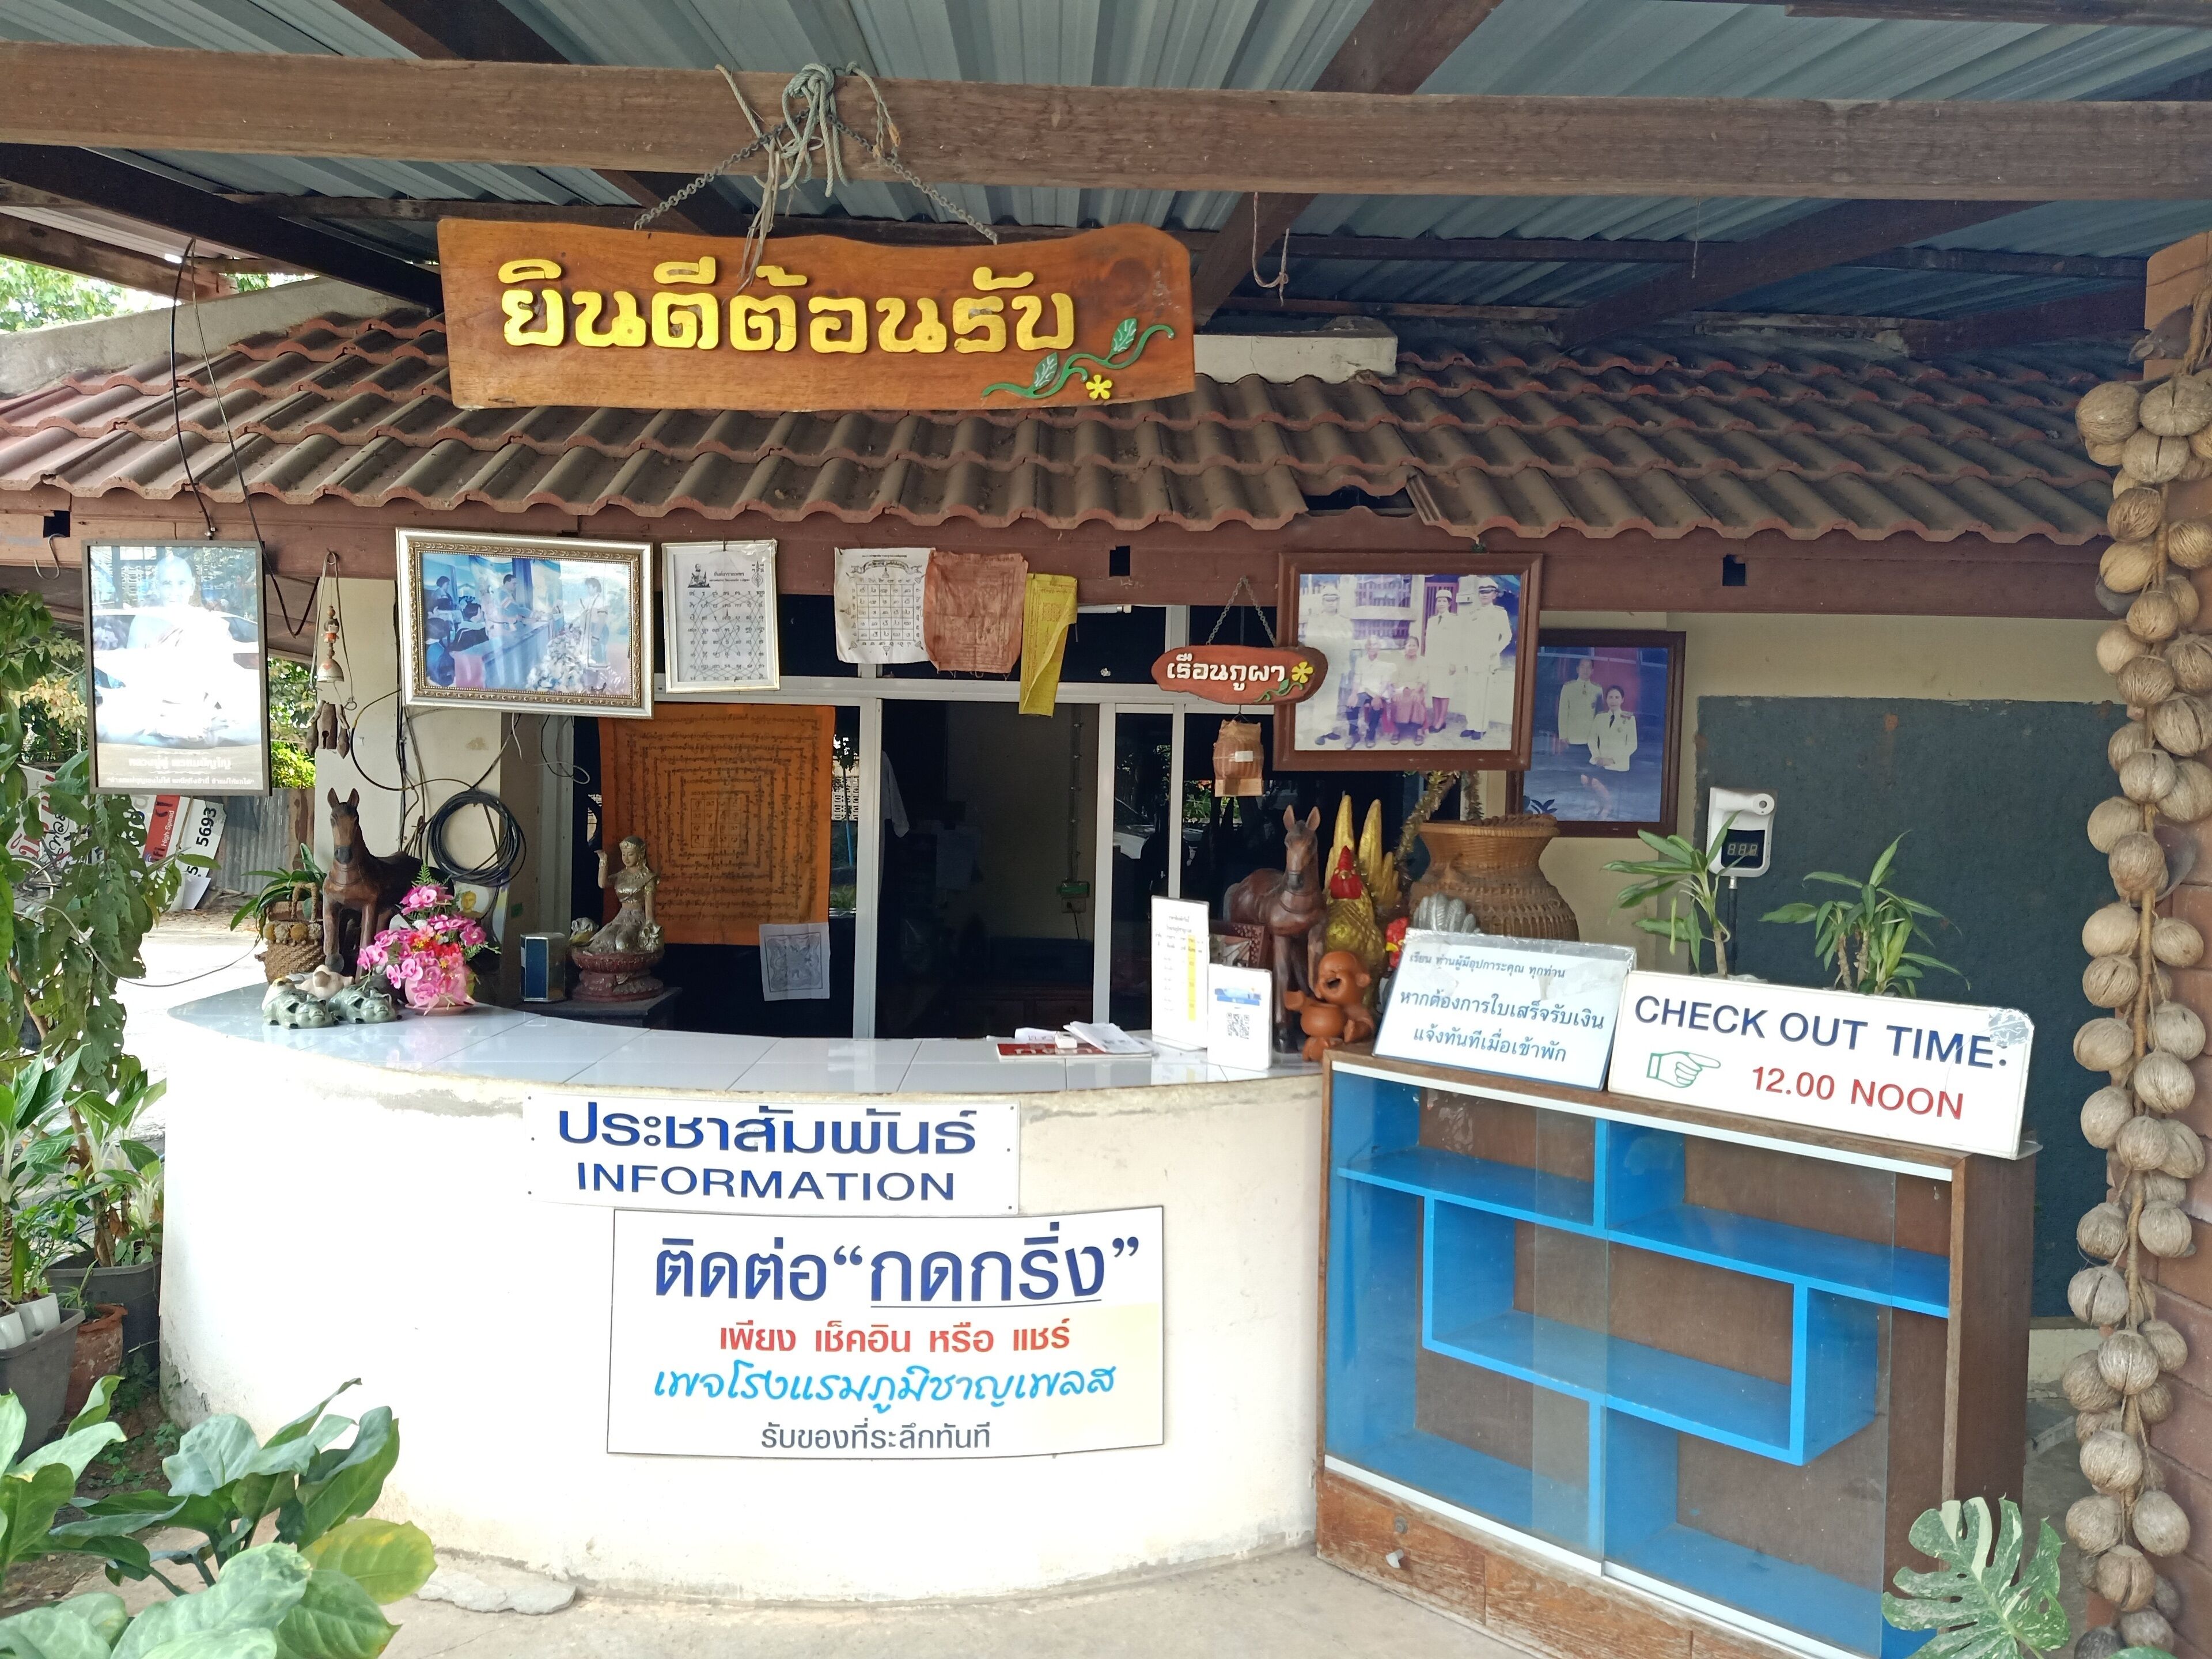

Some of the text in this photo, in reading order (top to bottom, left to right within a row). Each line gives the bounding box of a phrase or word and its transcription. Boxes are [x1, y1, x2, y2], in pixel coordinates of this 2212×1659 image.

[498, 256, 1075, 354] ยินดีต้อนรับ
[1167, 653, 1285, 691] เรือนภูผา
[161, 810, 175, 847] High-Speed
[196, 808, 217, 847] 5693
[1409, 951, 1431, 964] เรียน
[1529, 962, 1566, 979] ทุกท่าน
[1400, 989, 1605, 1029] หากต้องการใบเสร็จรับเงิน
[1634, 995, 1769, 1039] CHECK
[1779, 1012, 1869, 1050] OUT
[1414, 1023, 1567, 1062] แจ้งทันทีเมื่อเข้าพัก
[1752, 1066, 1964, 1120] 12.00 NOON
[558, 1101, 978, 1155] ประชาสัมพันธ์
[577, 1162, 955, 1202] INFORMATION
[720, 1318, 1070, 1353] เพียง เช็คอิน หรือ แชร์
[654, 1359, 1116, 1415] เพจโรงแรมภูมิชาญเพลส
[761, 1417, 991, 1449] รับของที่ระลึกทันที
